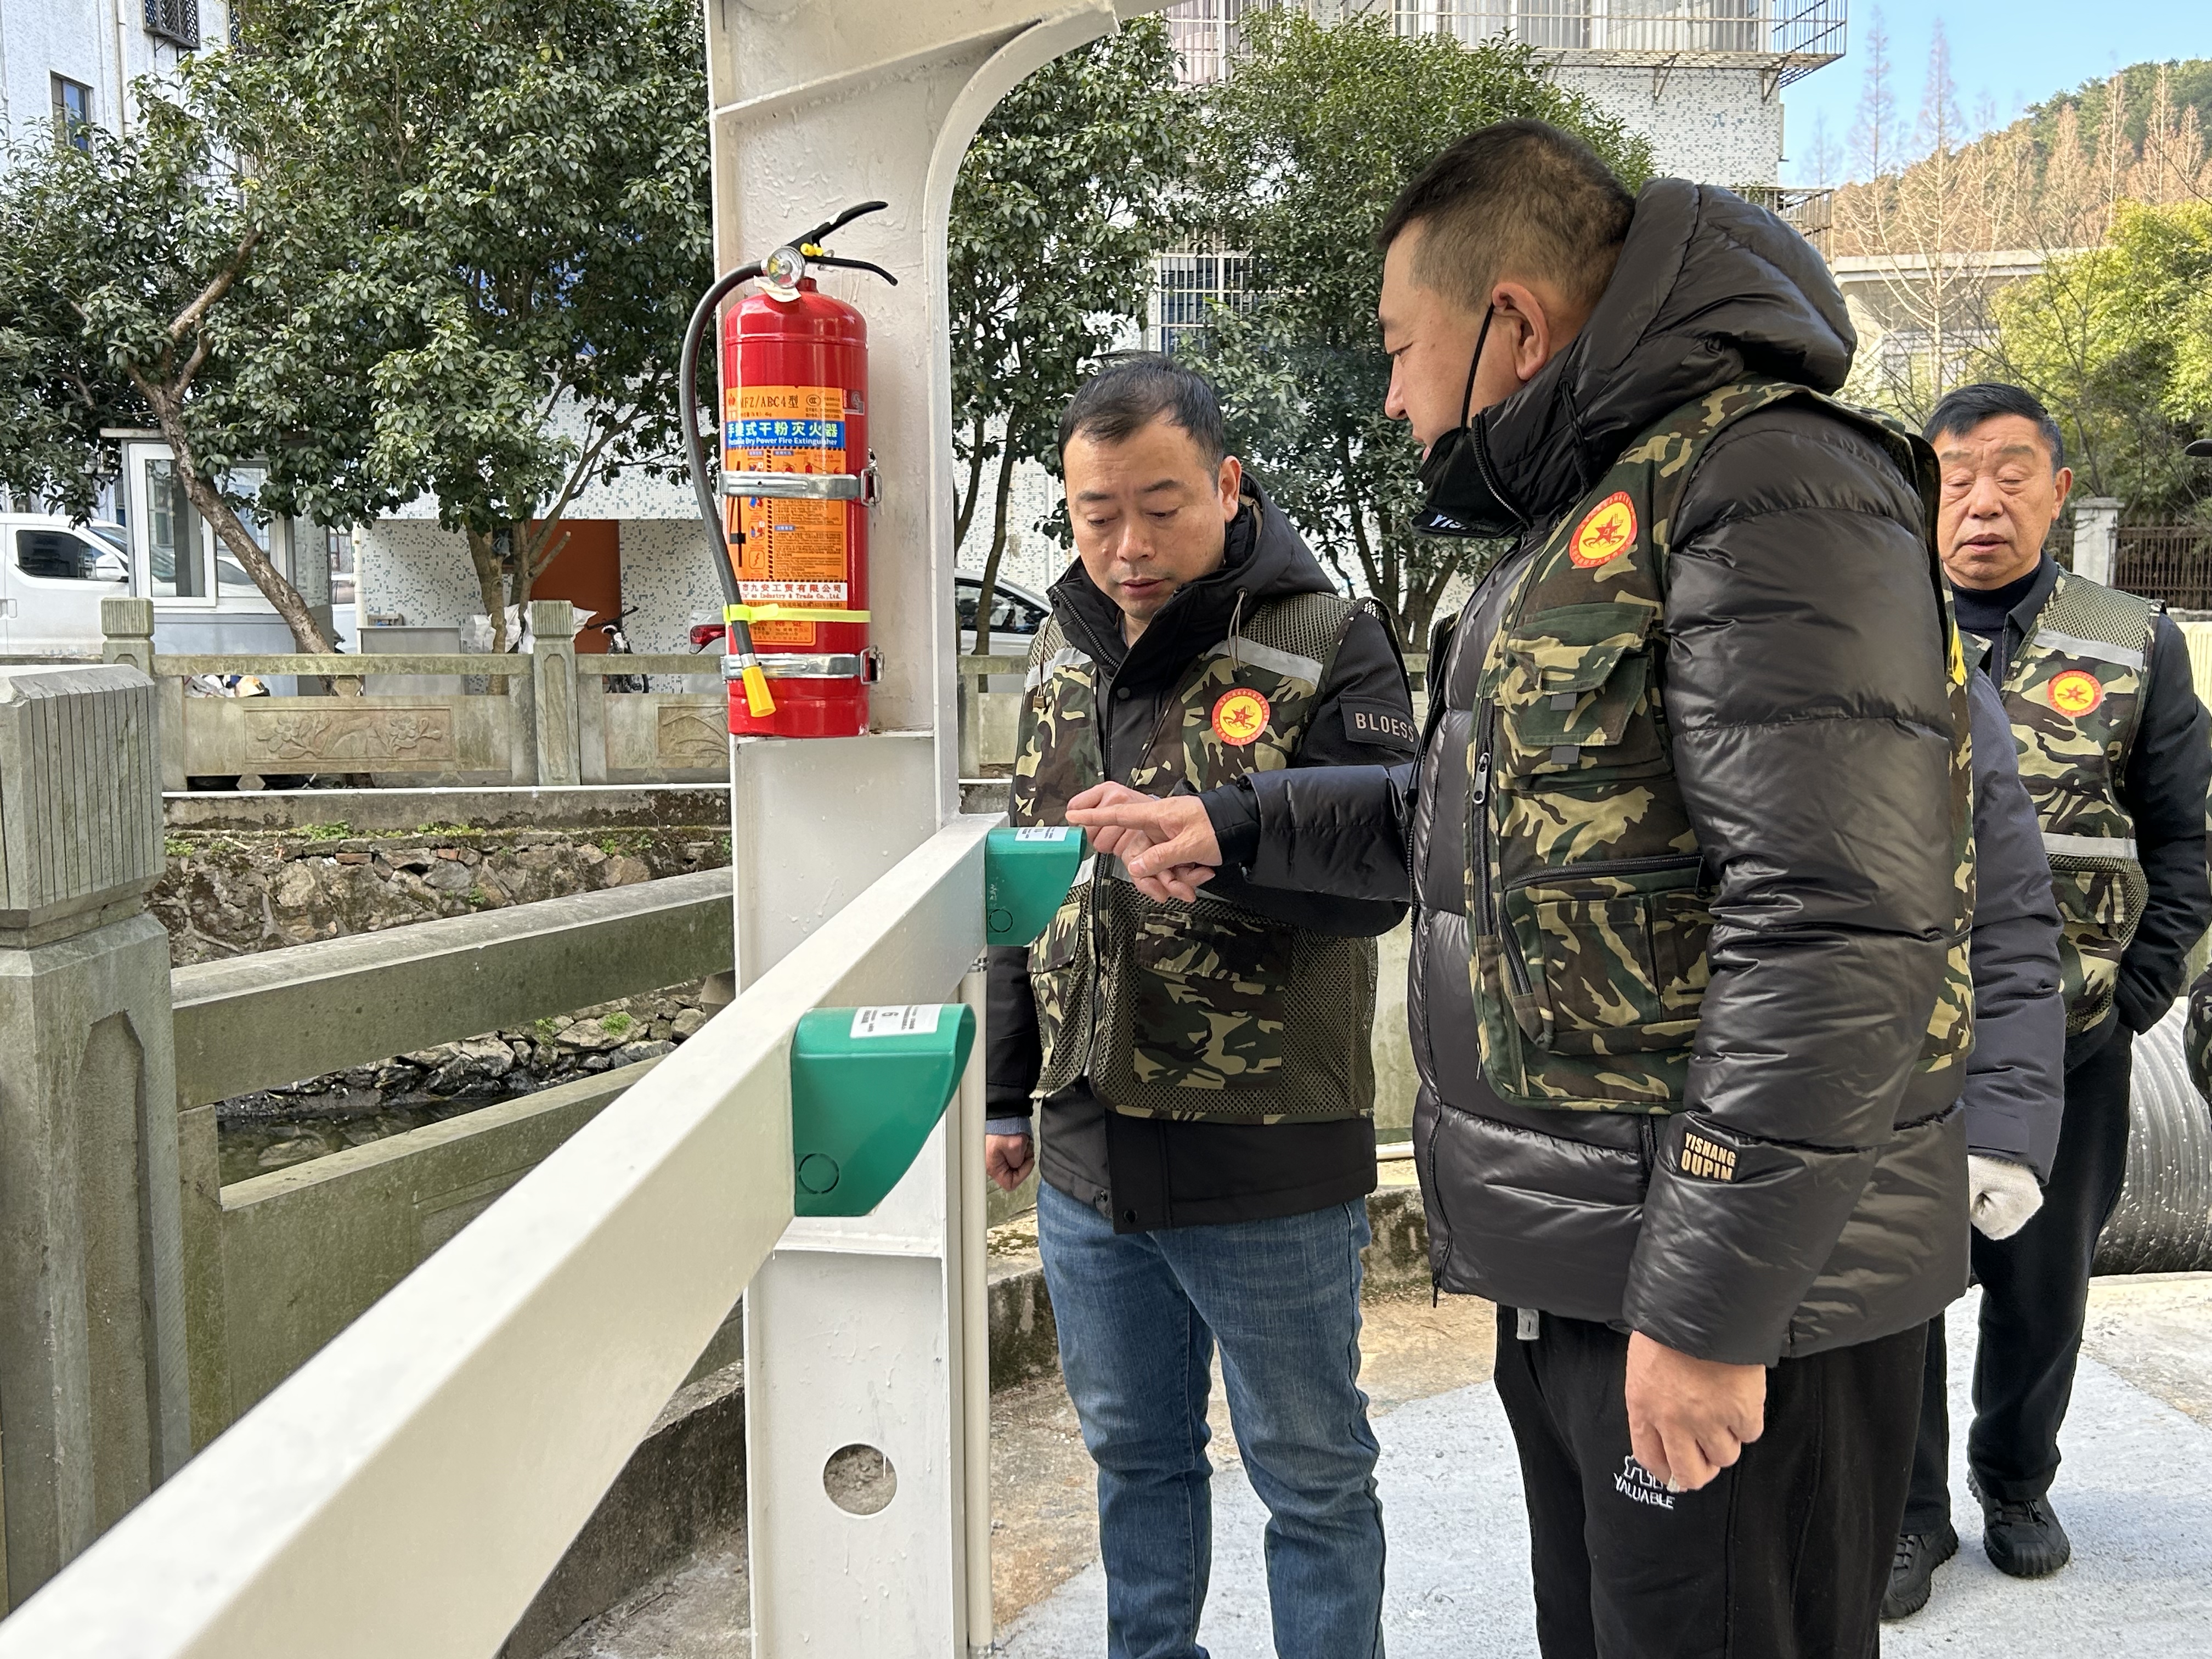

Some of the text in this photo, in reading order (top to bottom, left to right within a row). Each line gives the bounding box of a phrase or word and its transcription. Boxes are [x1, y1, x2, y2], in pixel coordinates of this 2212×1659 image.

[1429, 514, 1466, 530] YIS
[1355, 713, 1414, 743] BLOESS
[1681, 1149, 1733, 1181] OUPIN
[1685, 1132, 1736, 1167] YISHANG
